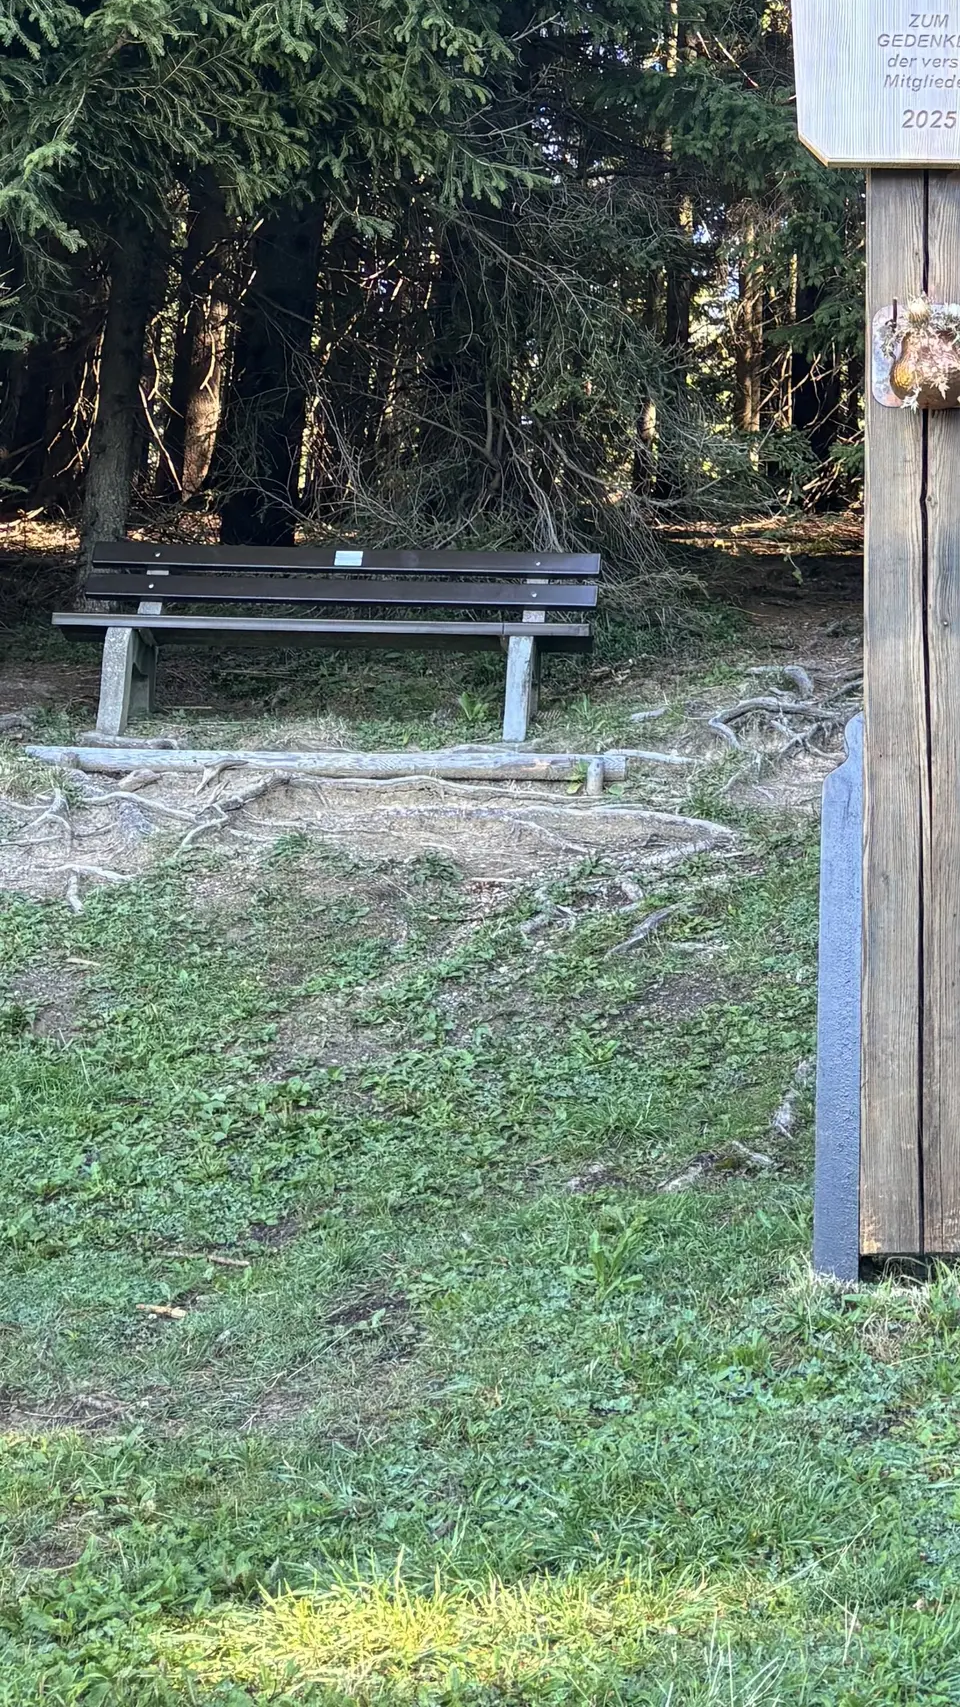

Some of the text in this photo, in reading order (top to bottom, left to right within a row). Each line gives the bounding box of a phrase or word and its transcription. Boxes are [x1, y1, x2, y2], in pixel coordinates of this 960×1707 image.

[908, 14, 949, 28] ZUM
[887, 54, 917, 68] der
[901, 109, 957, 129] 2025
